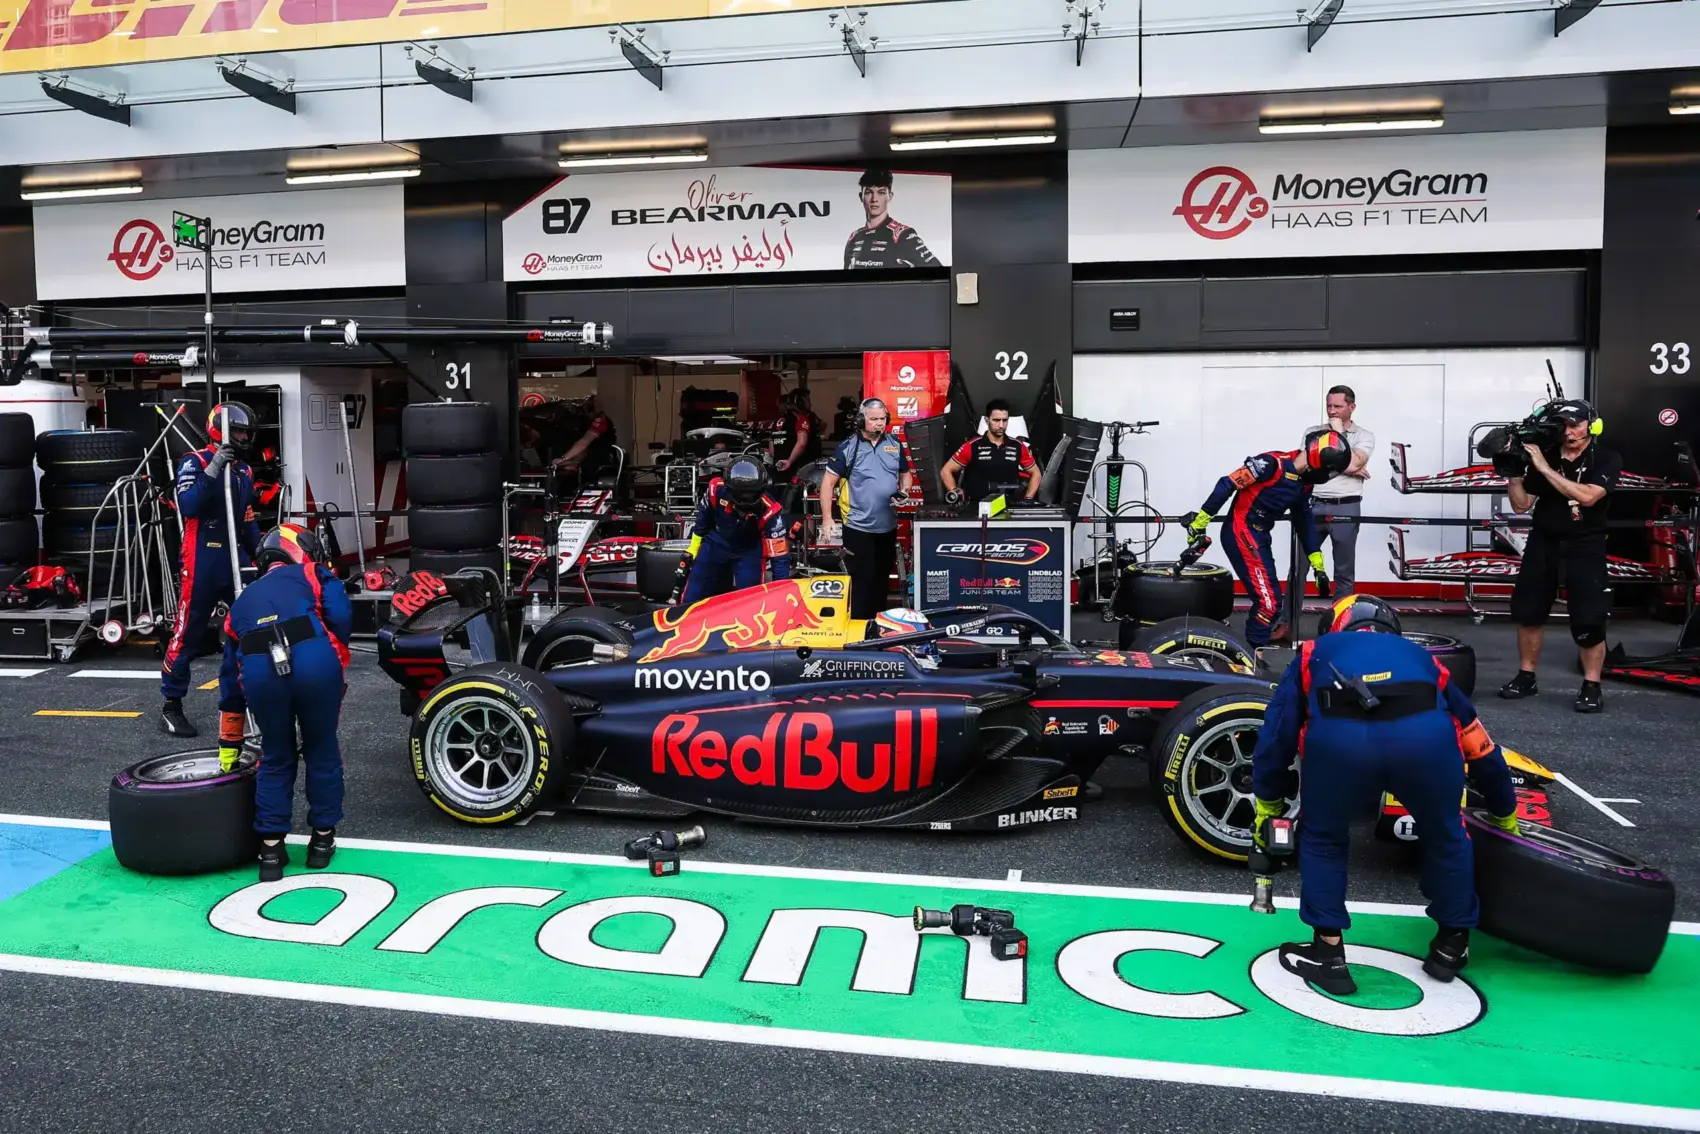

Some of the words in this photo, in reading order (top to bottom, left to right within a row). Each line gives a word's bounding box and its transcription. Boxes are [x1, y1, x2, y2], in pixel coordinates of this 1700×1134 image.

[687, 173, 752, 211] Oliver
[1272, 169, 1488, 205] MoneyGram
[542, 197, 591, 235] 87
[611, 200, 830, 226] BEARMAN
[1271, 211, 1354, 229] HAAS
[1364, 210, 1391, 226] F1
[1400, 206, 1488, 224] TEAM
[176, 255, 233, 271] HAAS
[239, 254, 260, 268] F1
[265, 251, 326, 267] TEAM
[547, 253, 603, 263] MoneyGram
[994, 350, 1029, 380] 32
[1649, 342, 1691, 375] 33
[445, 362, 471, 389] 31
[927, 569, 949, 577] MARTÍ
[1187, 634, 1228, 650] PIRELLI
[634, 665, 771, 691] movento
[411, 737, 425, 780] PIRELLI
[533, 724, 550, 793] ZERO
[1164, 733, 1190, 781] PIRELLI
[997, 806, 1078, 828] BLINKER
[207, 872, 1486, 1037] aramco
